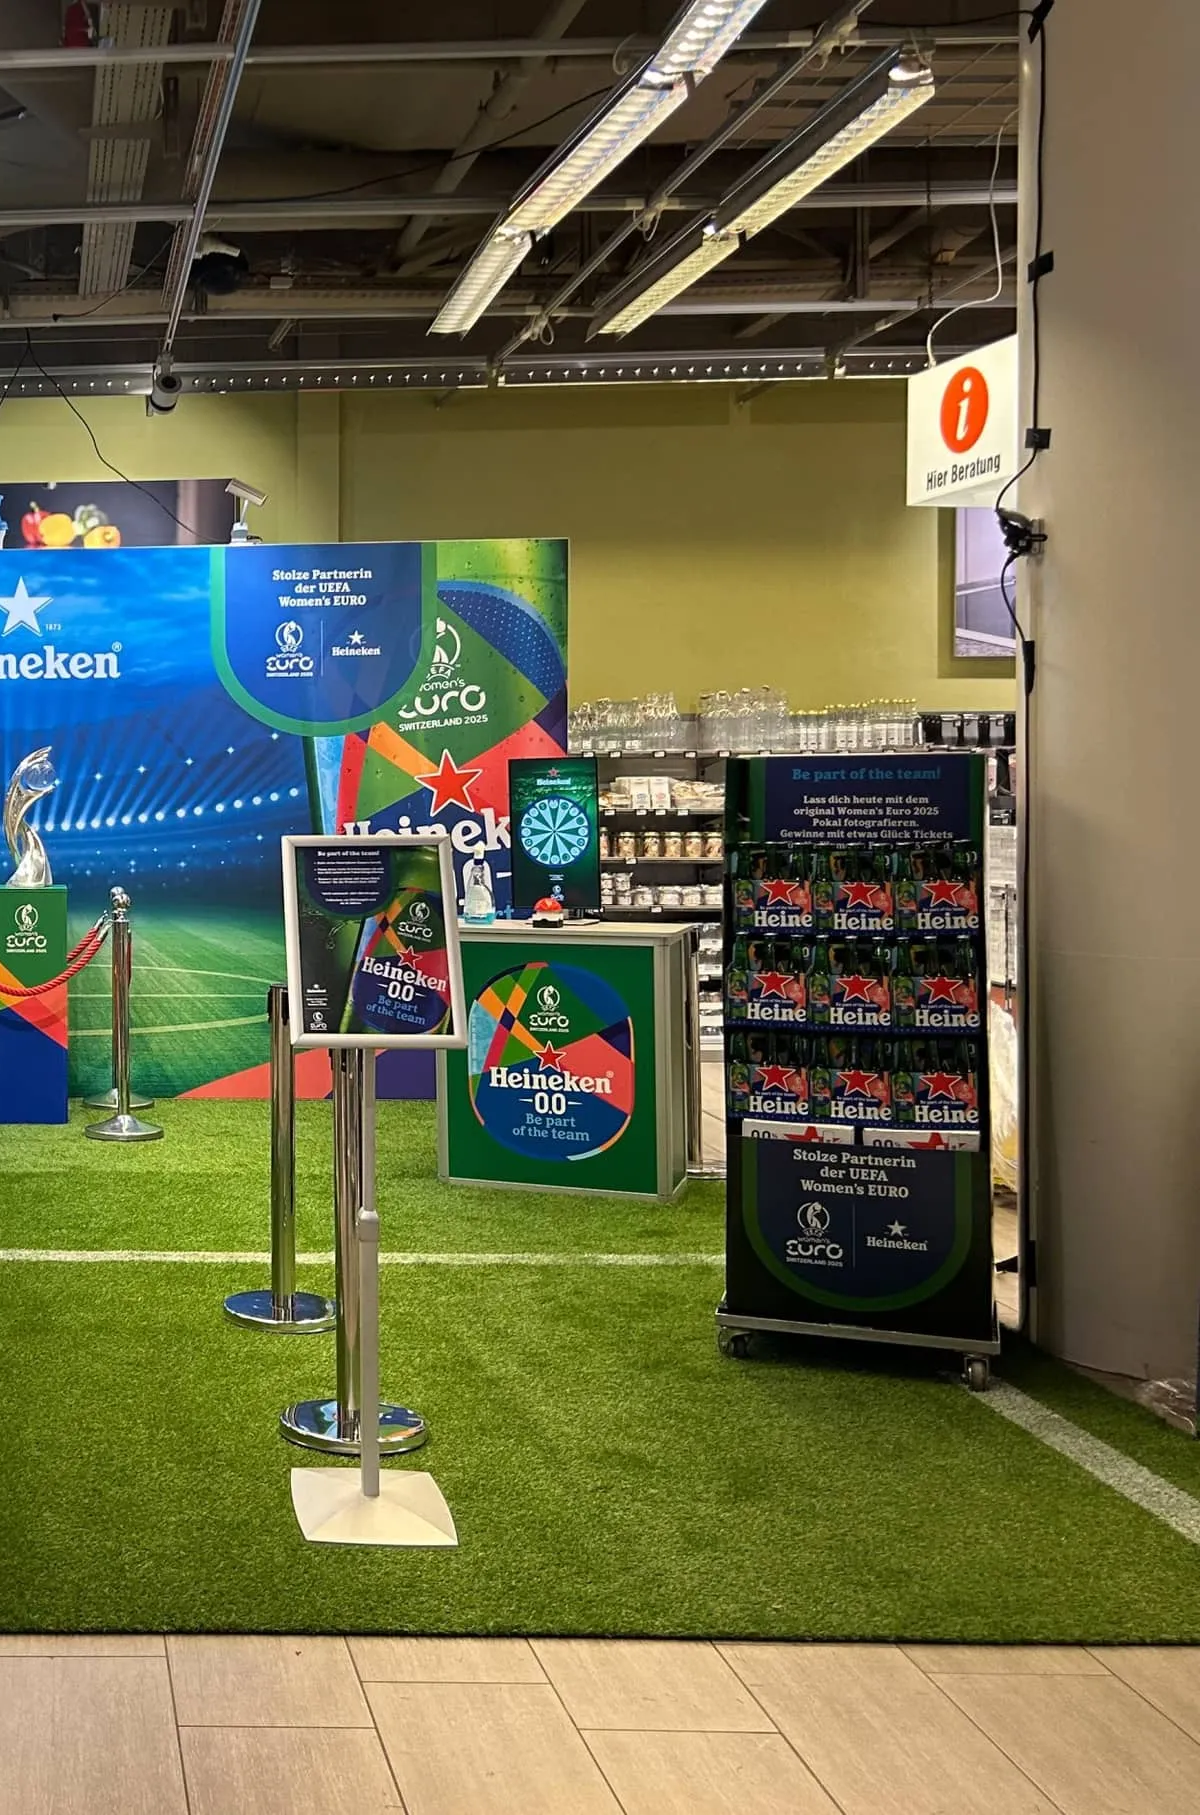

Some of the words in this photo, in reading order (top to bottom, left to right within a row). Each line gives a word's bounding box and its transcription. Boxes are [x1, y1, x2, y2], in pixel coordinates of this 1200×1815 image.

[926, 469, 948, 491] Hier
[951, 454, 1001, 484] Beratung
[272, 569, 310, 580] Stolze
[312, 568, 373, 580] Partnerin
[294, 583, 316, 593] der
[318, 582, 351, 593] UEFA
[278, 596, 331, 607] Women's
[333, 595, 367, 606] EURO
[398, 717, 463, 732] SWITZERLAND
[464, 714, 489, 725] 2025
[792, 768, 811, 780] Be
[814, 768, 846, 782] part
[850, 768, 868, 780] of
[868, 768, 895, 780] the
[897, 766, 942, 780] team!
[803, 796, 826, 804] Lass
[828, 795, 850, 804] dich
[852, 795, 884, 804] heute
[885, 795, 904, 804] mit
[905, 795, 929, 804] dem
[793, 807, 835, 818] original
[837, 807, 884, 816] Women's
[886, 807, 911, 816] Euro
[913, 807, 940, 816] 2025
[812, 818, 842, 827] Pokal
[843, 818, 920, 829] fotografieren.
[780, 830, 825, 838] Gewinne
[827, 829, 845, 838] mit
[847, 830, 878, 838] etwas
[880, 829, 911, 838] Glück
[912, 829, 953, 839] Tickets
[753, 910, 813, 928] Heine
[833, 912, 895, 931] Heine
[917, 912, 980, 930] Heine
[361, 956, 448, 993] Heineken
[377, 1004, 395, 1017] the
[395, 1009, 426, 1026] team
[394, 1001, 418, 1014] part
[746, 1002, 807, 1022] Heine
[829, 1006, 891, 1026] Heine
[915, 1008, 981, 1028] Heine
[489, 1066, 613, 1094] Heineken
[534, 1092, 567, 1115] 0.0
[749, 1096, 809, 1116] Heine
[830, 1099, 892, 1121] Heine
[525, 1113, 542, 1125] Be
[543, 1114, 576, 1129] part
[914, 1103, 980, 1124] Heine
[512, 1125, 527, 1137] of
[527, 1126, 549, 1138] the
[551, 1128, 590, 1141] team
[793, 1149, 838, 1163] Stolze
[841, 1152, 916, 1169] Partnerin
[820, 1166, 846, 1179] der
[849, 1168, 888, 1182] UEFA
[800, 1179, 865, 1196] Women's
[867, 1185, 909, 1199] EURO
[866, 1236, 927, 1251] Heineken
